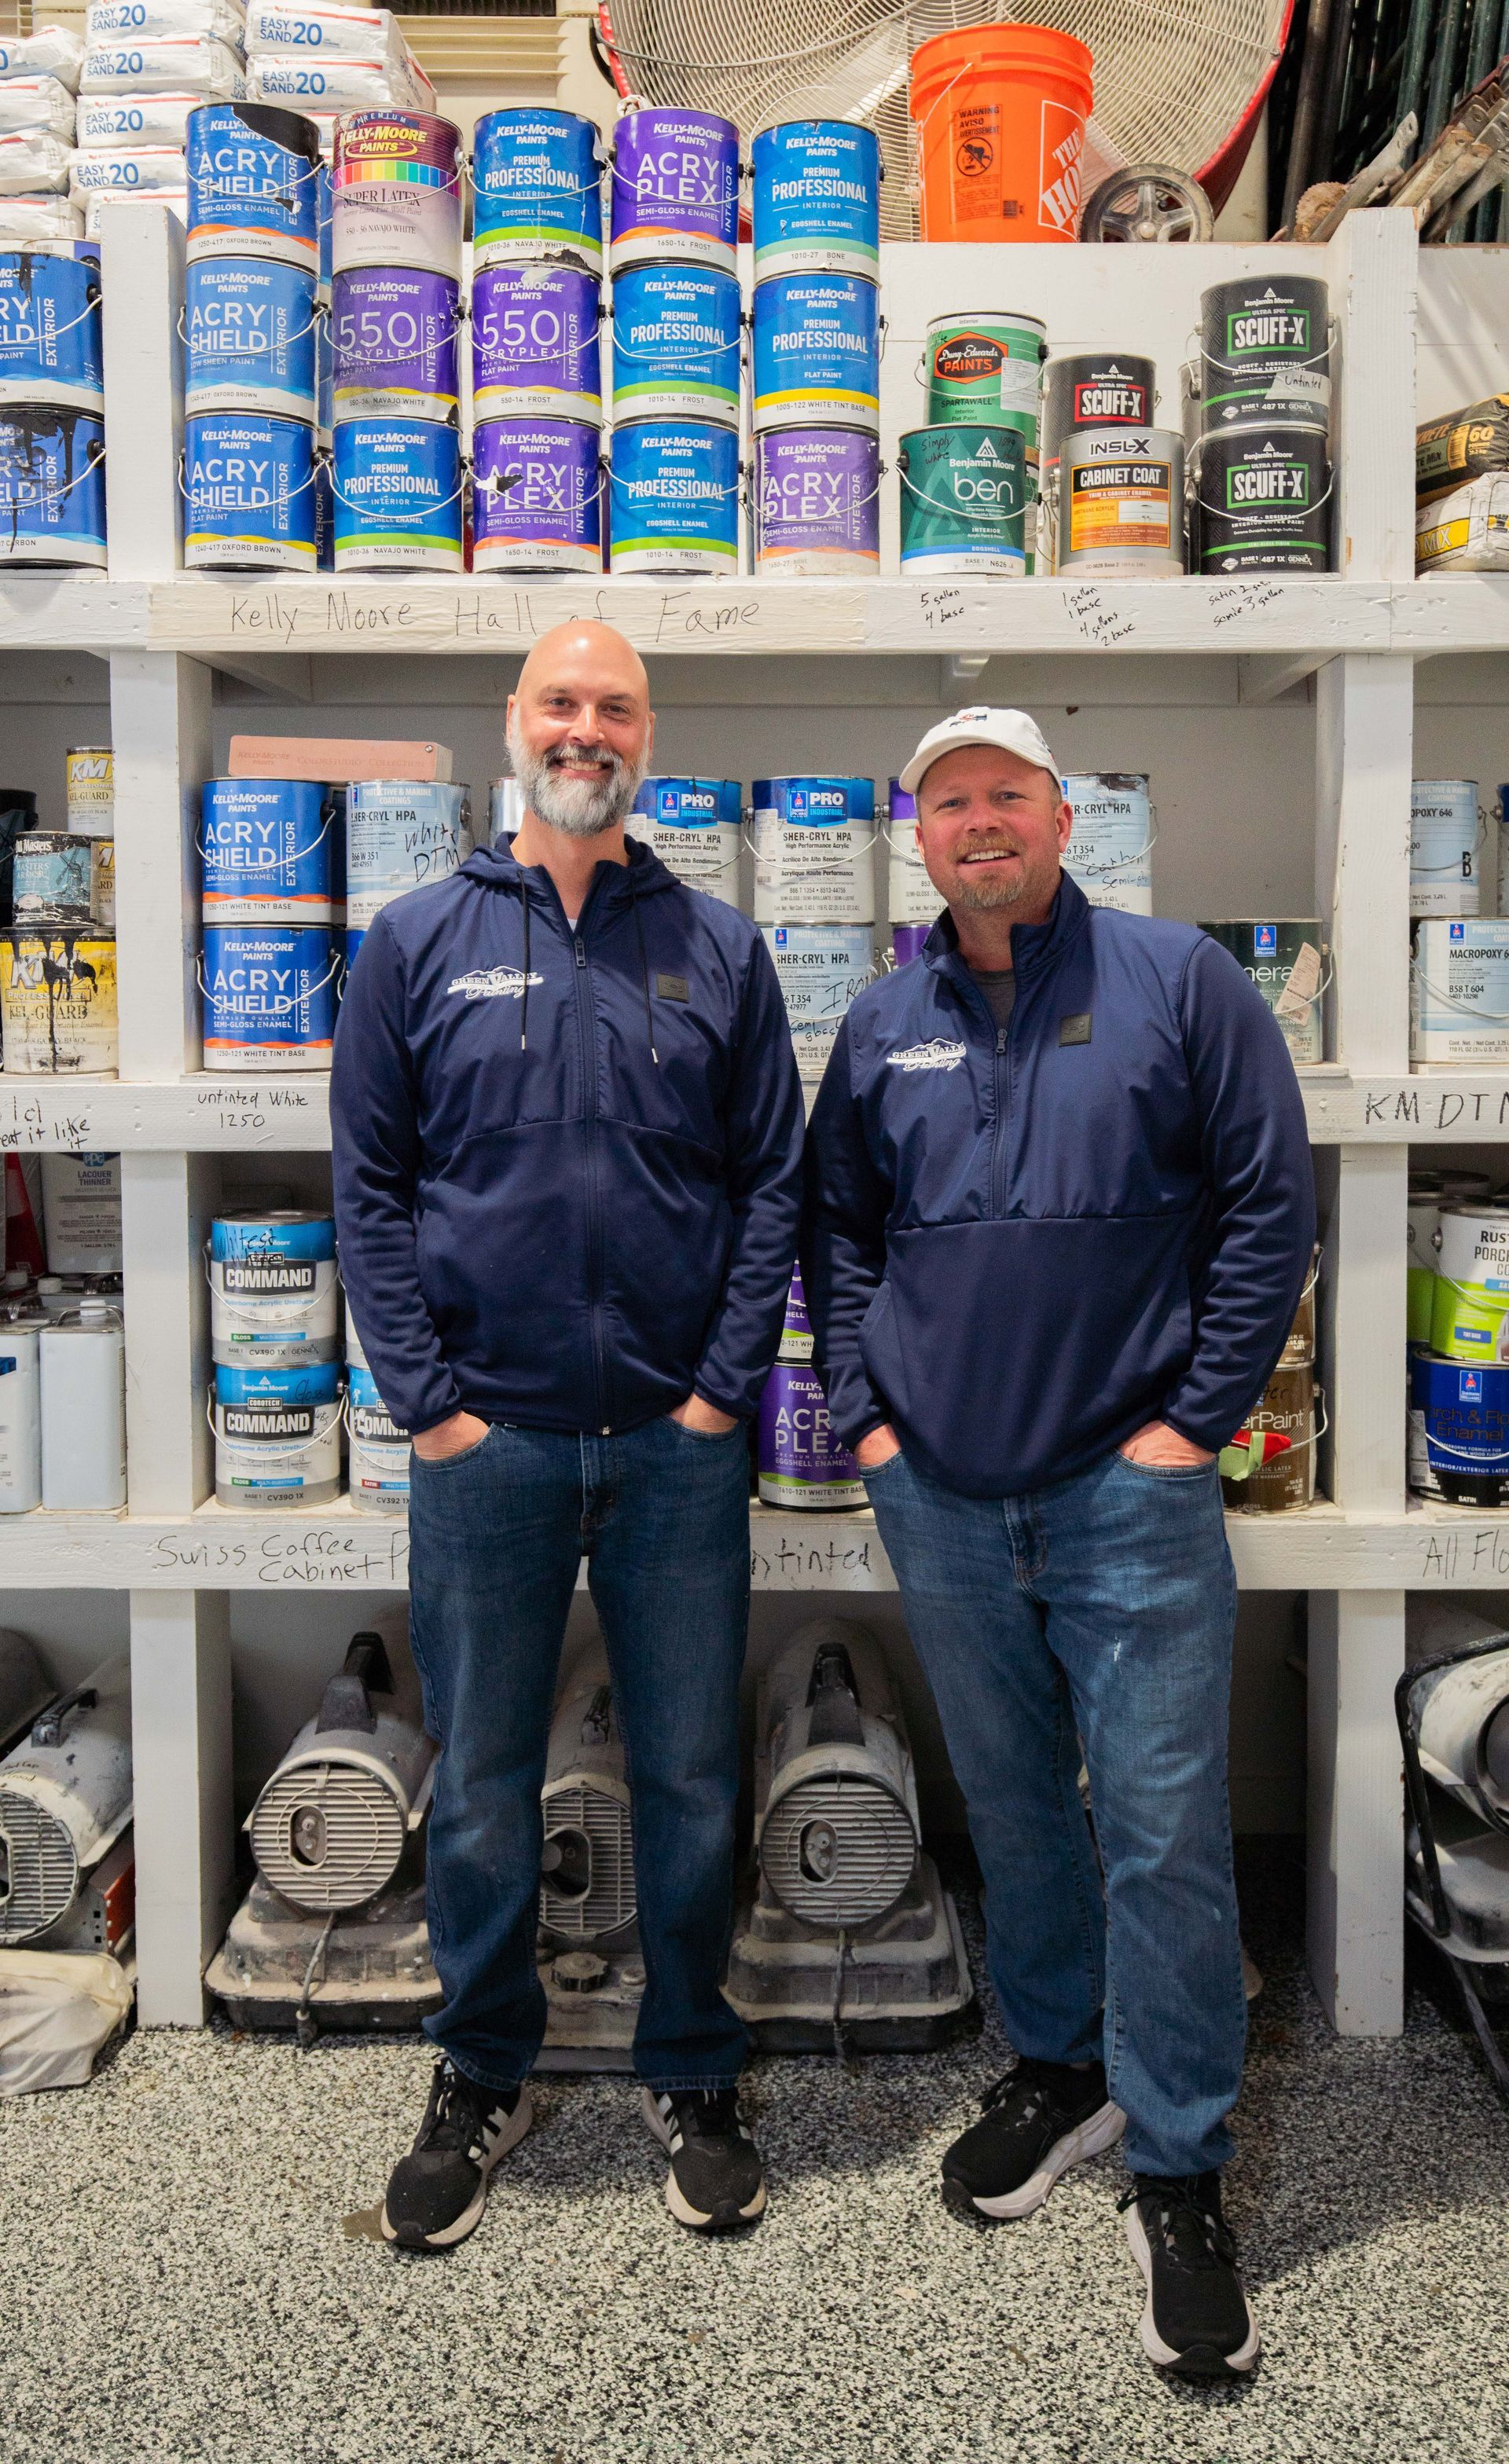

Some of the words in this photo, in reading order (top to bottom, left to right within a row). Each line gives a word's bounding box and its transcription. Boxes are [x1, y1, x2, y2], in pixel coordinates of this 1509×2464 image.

[259, 17, 290, 31] EASY
[259, 30, 294, 43] SAND
[293, 21, 322, 46] 20
[86, 112, 110, 124] EASY
[960, 106, 999, 118] WARNING
[86, 124, 115, 135] SAND
[115, 109, 143, 132] 20
[497, 124, 568, 138] KELLY-MOORE
[340, 126, 428, 145] KELLY-MOORE
[516, 136, 548, 145] PAINTS
[654, 123, 723, 142] KELLY-MOORE
[359, 141, 398, 152] PAINTS
[786, 136, 856, 150] KELLY-MOORE
[1052, 127, 1081, 167] THE
[197, 150, 280, 174] ACRY
[513, 156, 550, 166] PREMIUM
[637, 152, 720, 180] ACRY
[197, 176, 280, 200] SHIELD
[485, 168, 582, 190] PROFESSIONAL
[637, 178, 718, 204] PLEX
[773, 179, 868, 204] PROFESSIONAL
[198, 204, 241, 213] SEMI-GLOSS
[244, 204, 281, 215] ENAMEL
[658, 239, 685, 248] 1650-14
[200, 273, 271, 285] KELLY-MOORE
[217, 284, 248, 293] PAINTS
[191, 303, 266, 329] ACRY
[661, 312, 698, 322] PREMIUM
[44, 298, 56, 367] EXTERIOR
[340, 312, 417, 350] 550
[482, 310, 560, 350] 550
[631, 323, 726, 347] PROFESSIONAL
[1235, 317, 1304, 347] SCUFF-X
[190, 329, 267, 354] SHIELD
[277, 307, 287, 376] EXTERIOR
[427, 316, 436, 383] INTERIOR
[773, 332, 868, 354] PROFESSIONAL
[944, 358, 992, 372] PAINTS
[777, 402, 806, 411] 1005-122
[851, 404, 865, 412] BASE
[1082, 390, 1141, 416] SCUFF-X
[355, 434, 427, 446] KELLY-MOORE
[1469, 427, 1494, 442] 60
[374, 444, 405, 453] PAINTS
[1089, 437, 1153, 456] INSL-X
[192, 460, 269, 484] ACRY
[658, 468, 695, 478] PREMIUM
[949, 458, 989, 469] Benjamin
[991, 459, 1015, 471] Moore
[344, 476, 441, 496] PROFESSIONAL
[766, 472, 843, 500] ACRY
[1080, 469, 1129, 487] CABINET
[1133, 468, 1161, 486] COAT
[1234, 471, 1302, 499] SCUFF-X
[279, 464, 288, 530] EXTERIOR
[954, 472, 1013, 504] ben
[254, 545, 281, 554] BROWN
[1424, 527, 1452, 555] MIX
[921, 592, 930, 608] 5
[232, 596, 298, 644] Kelly
[328, 592, 415, 631] Moore
[455, 593, 538, 636] Hall
[655, 592, 762, 643] Fame
[925, 611, 933, 629] 4
[1080, 622, 1089, 637] 4
[1101, 636, 1110, 647] 2
[72, 758, 109, 782] KM
[213, 794, 279, 804] KELLY-MOORE
[810, 792, 843, 806] PRO
[396, 811, 416, 821] HPA
[206, 822, 275, 845] ACRY
[783, 832, 832, 842] SHER-CRYL
[836, 831, 852, 842] HPA
[286, 822, 296, 886] EXTERIOR
[414, 845, 461, 882] DTM
[1463, 852, 1471, 877] B
[224, 942, 294, 952] KELLY-MOORE
[1449, 949, 1501, 959] MACROPOXY
[832, 953, 850, 964] HPA
[213, 970, 291, 991] ACRY
[214, 996, 292, 1014] SHIELD
[1366, 1091, 1419, 1124] KM
[54, 1116, 90, 1140] like
[219, 1113, 265, 1128] 1250
[69, 1138, 88, 1150] it
[226, 1268, 312, 1287] COMMAND
[226, 1414, 310, 1432] COMMAND
[1437, 1422, 1503, 1440] Enamel
[775, 1458, 812, 1467] EGGSHELL
[156, 1535, 247, 1568] Swiss
[262, 1531, 356, 1557] Coffee
[751, 1538, 872, 1577] ntinted
[1423, 1536, 1457, 1579] All
[259, 1554, 384, 1582] Cabinet
